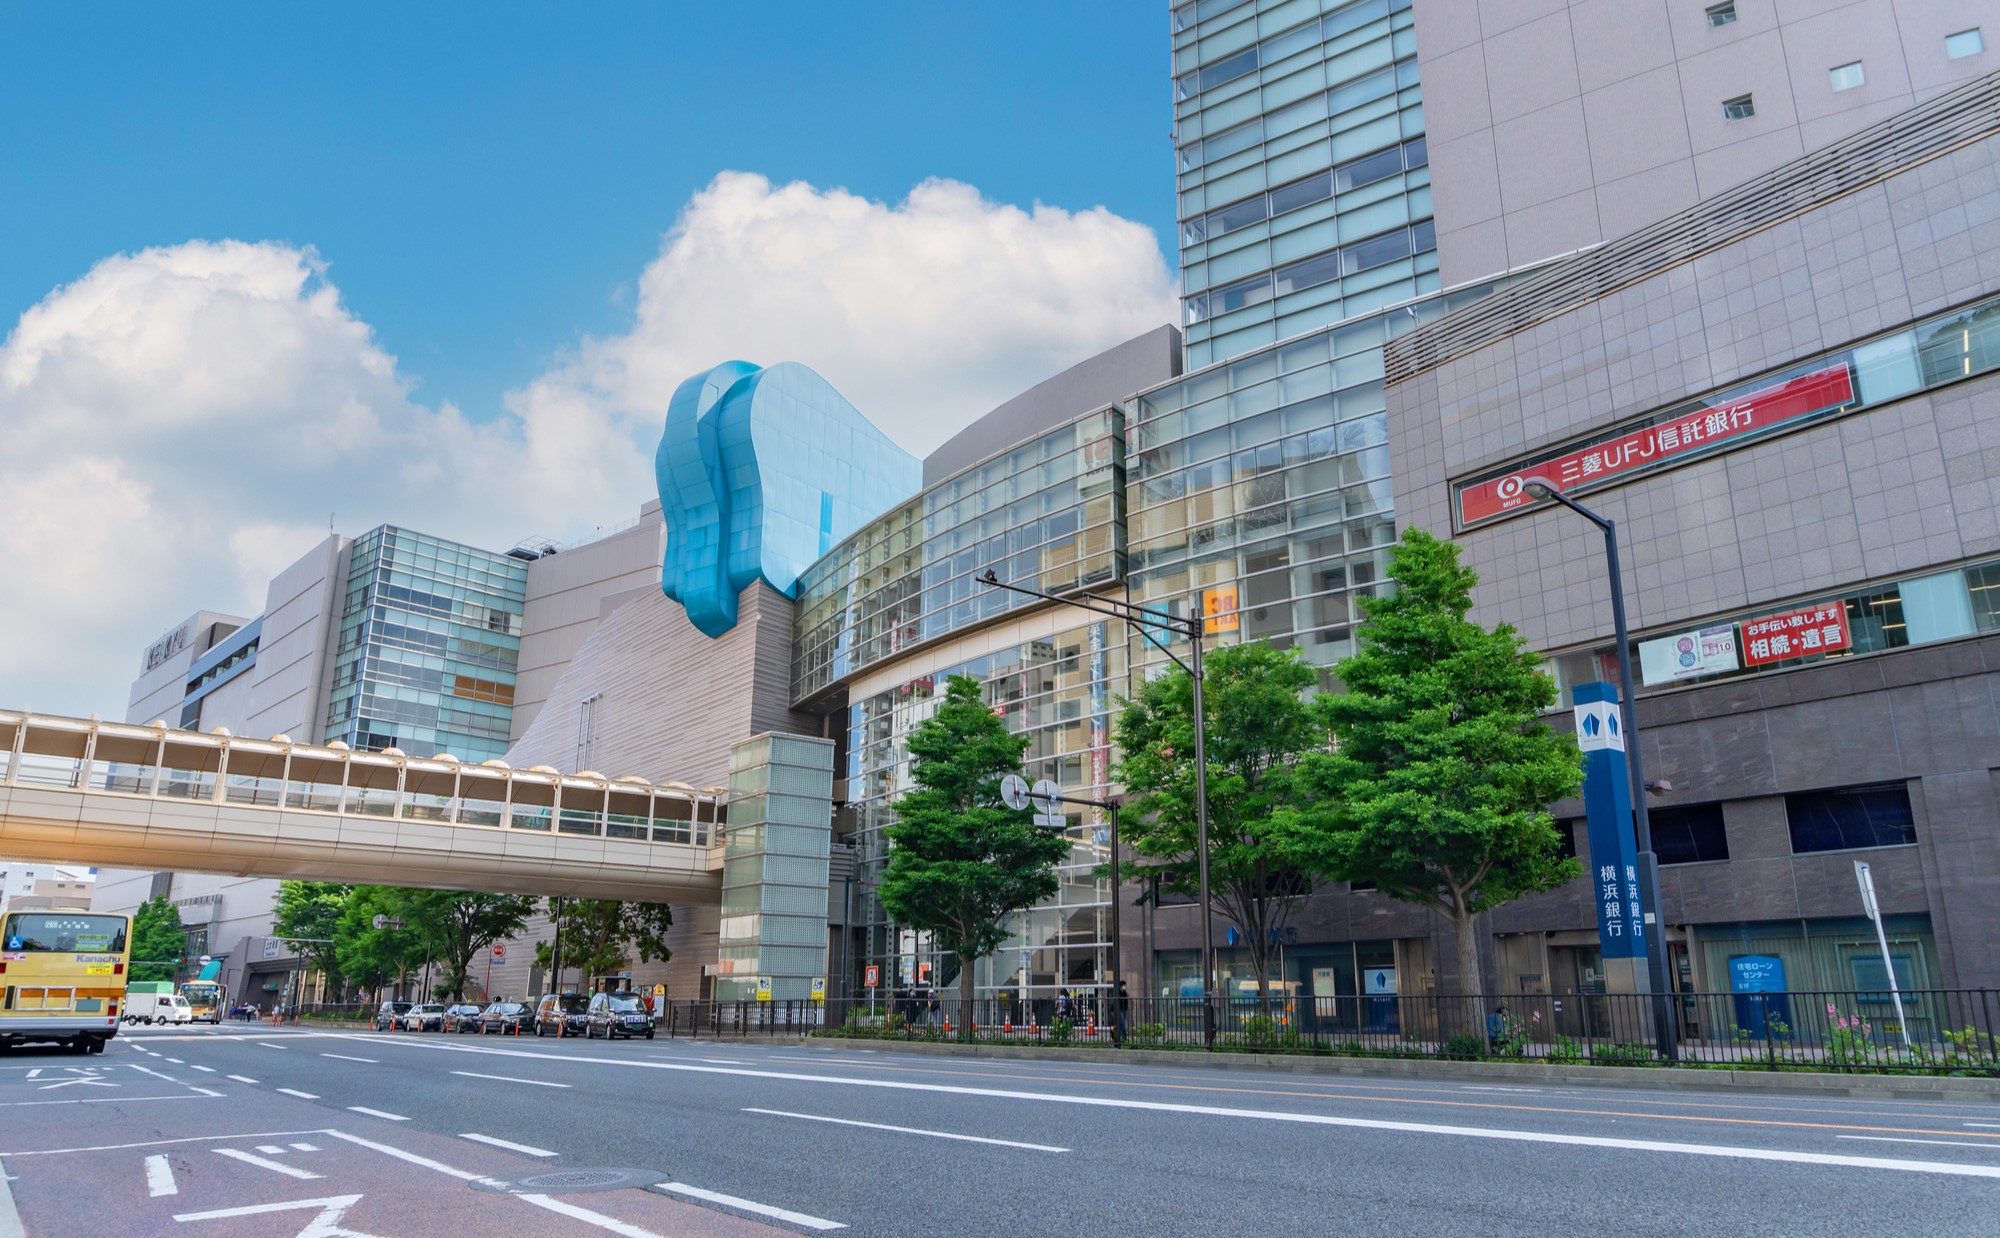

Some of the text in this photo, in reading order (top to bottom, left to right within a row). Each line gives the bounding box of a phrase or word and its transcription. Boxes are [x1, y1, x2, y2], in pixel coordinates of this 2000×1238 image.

[1561, 403, 1754, 483] 三菱UFJ信託銀行
[1503, 498, 1521, 508] MUFG
[1748, 608, 1837, 636] お手伝い致します
[1750, 624, 1842, 659] 相続・遺言
[1601, 865, 1622, 937] 横浜銀行
[1626, 865, 1642, 937] 横浜銀行
[76, 954, 121, 963] Kanachu
[1737, 962, 1773, 971] 住宅ローン
[1743, 971, 1770, 979] センター
